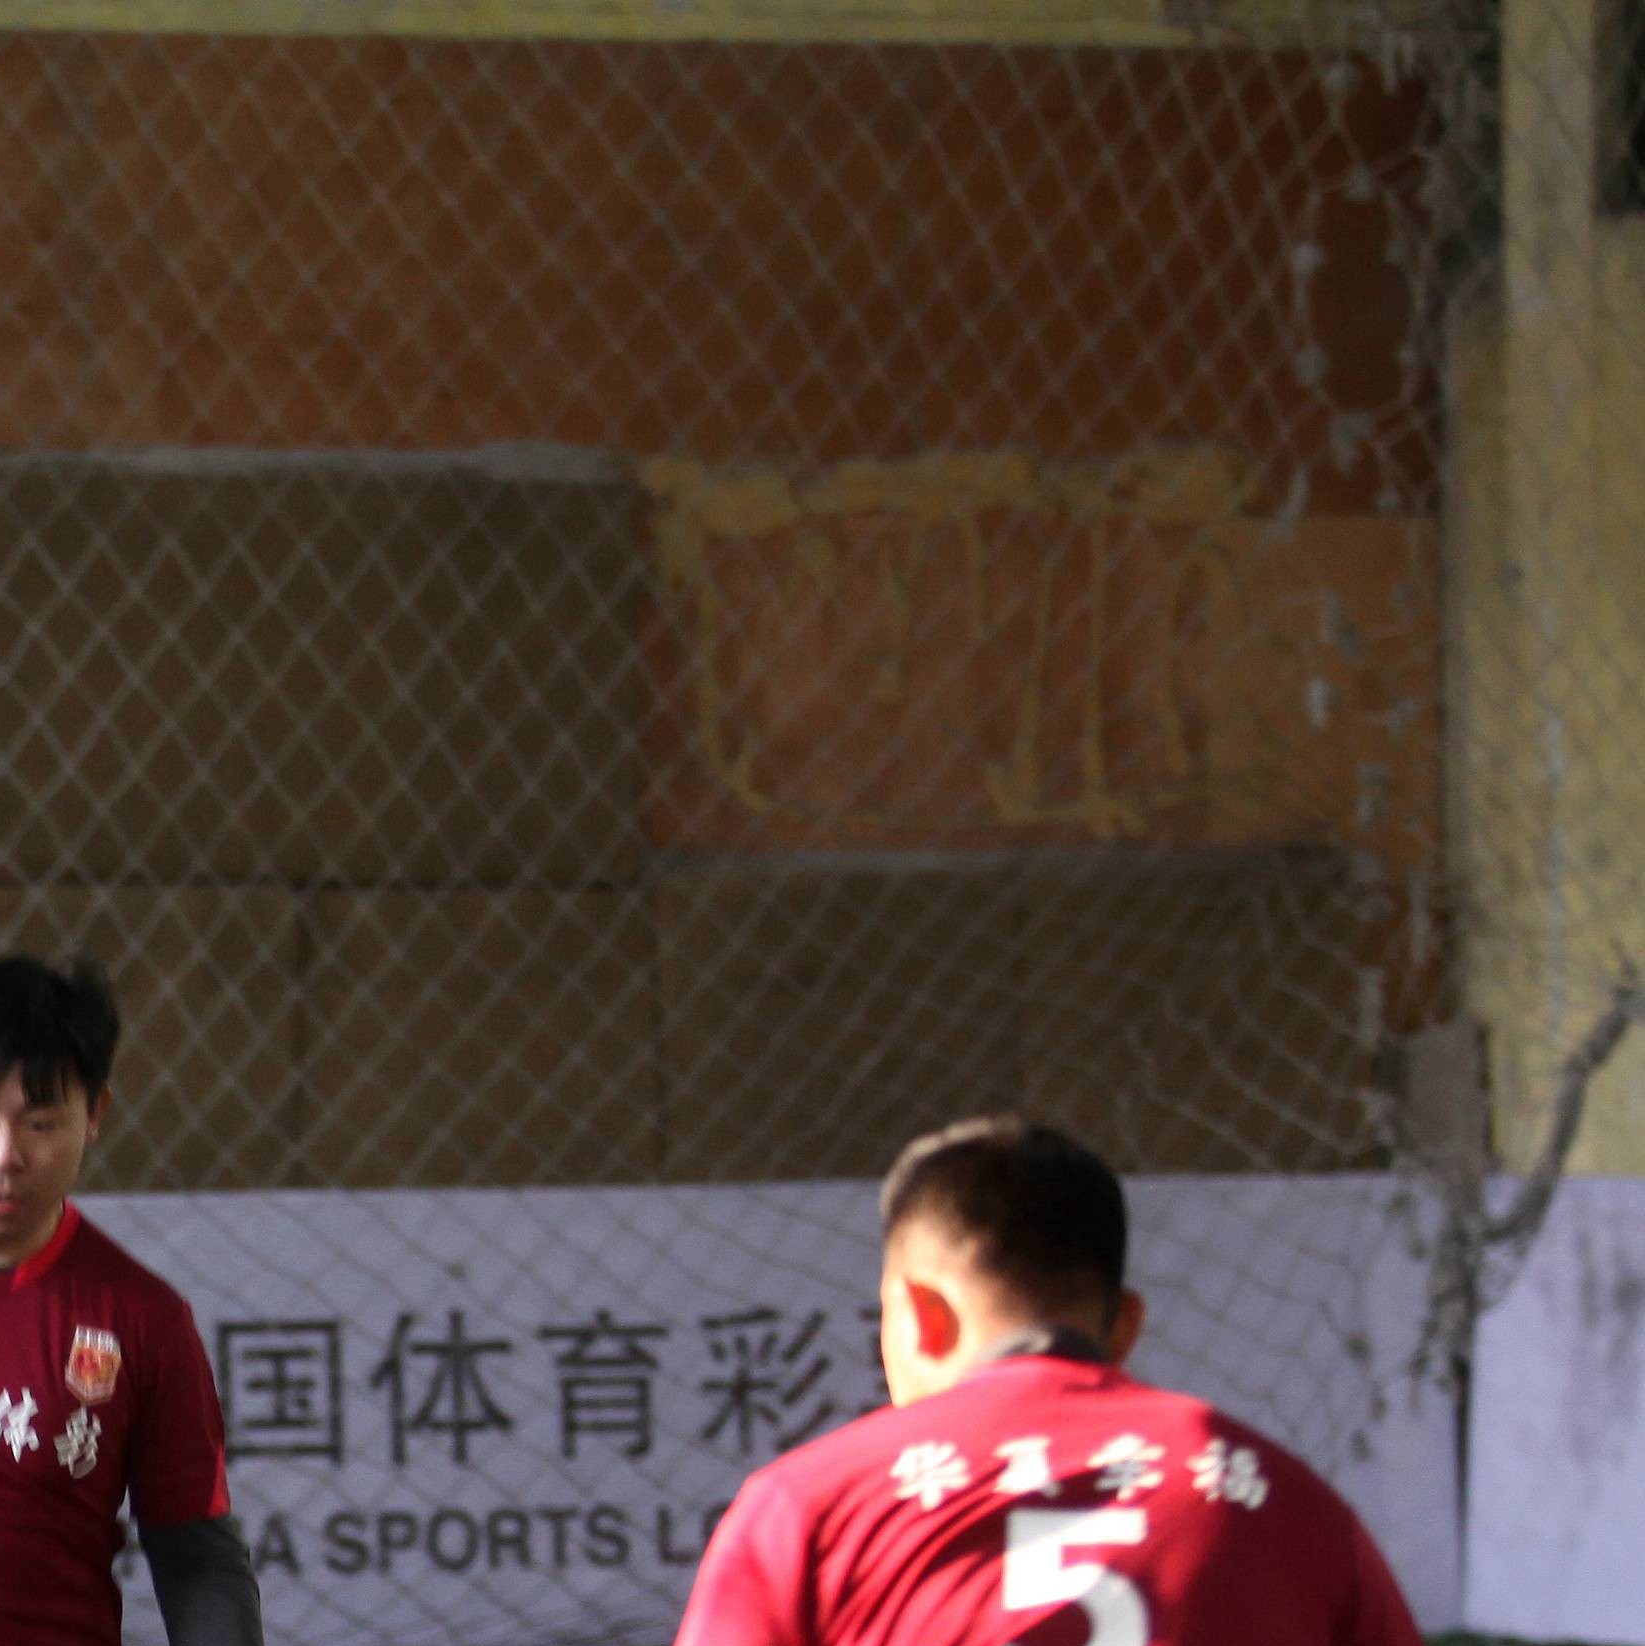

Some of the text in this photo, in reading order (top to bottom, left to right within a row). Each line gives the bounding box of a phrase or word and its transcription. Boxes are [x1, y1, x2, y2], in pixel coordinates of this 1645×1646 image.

[217, 1306, 885, 1466] 国体育彩
[325, 1508, 630, 1575] SPORTS
